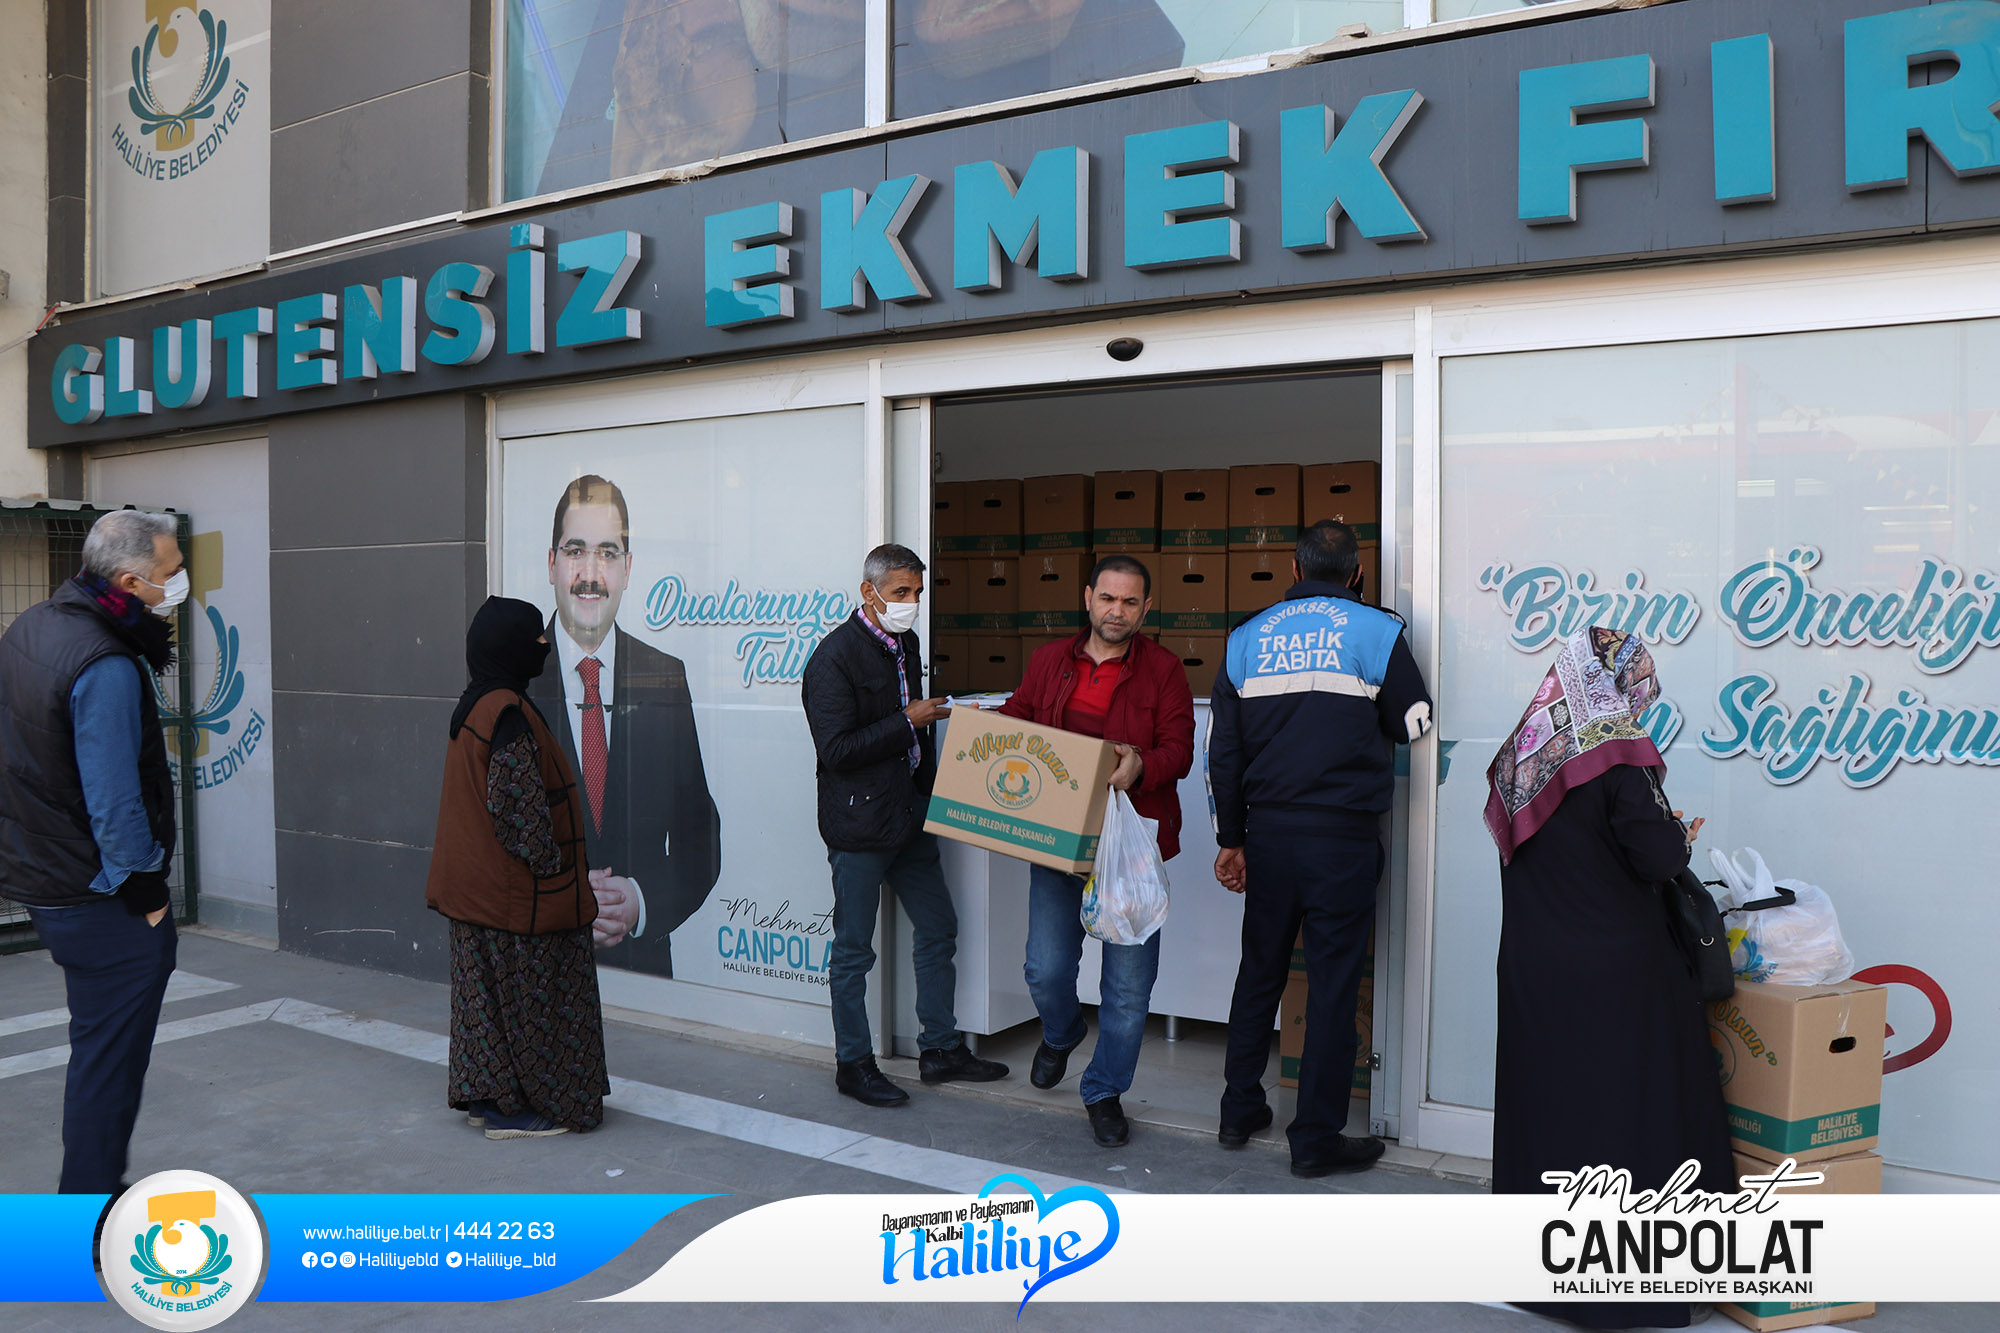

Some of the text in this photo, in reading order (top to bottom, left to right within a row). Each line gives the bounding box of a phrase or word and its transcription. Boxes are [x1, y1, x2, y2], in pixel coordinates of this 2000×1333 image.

[112, 78, 250, 181] HALİLİYE BELEDİYESİ
[51, 1, 2000, 425] GLUTENSİZ EKMEK FIR
[646, 576, 853, 638] Dualarınıza
[1260, 601, 1348, 634] BÜYÜKŞEHİR
[1258, 627, 1344, 653] TRAFİK
[1257, 649, 1341, 673] ZABITA
[1702, 675, 2000, 782] Sağlığını
[193, 708, 265, 790] ELEDİYESİ
[946, 807, 1056, 846] HALİLİYE BELEDİYE BAŞKANLIĞI
[720, 898, 834, 935] Mehmet
[718, 925, 833, 973] CANPOLA
[723, 962, 831, 986] HALİLİYE BELEDİYE BAŞK
[1810, 1124, 1863, 1146] BELEDİYESİ
[1817, 1112, 1858, 1131] HALİLİYE
